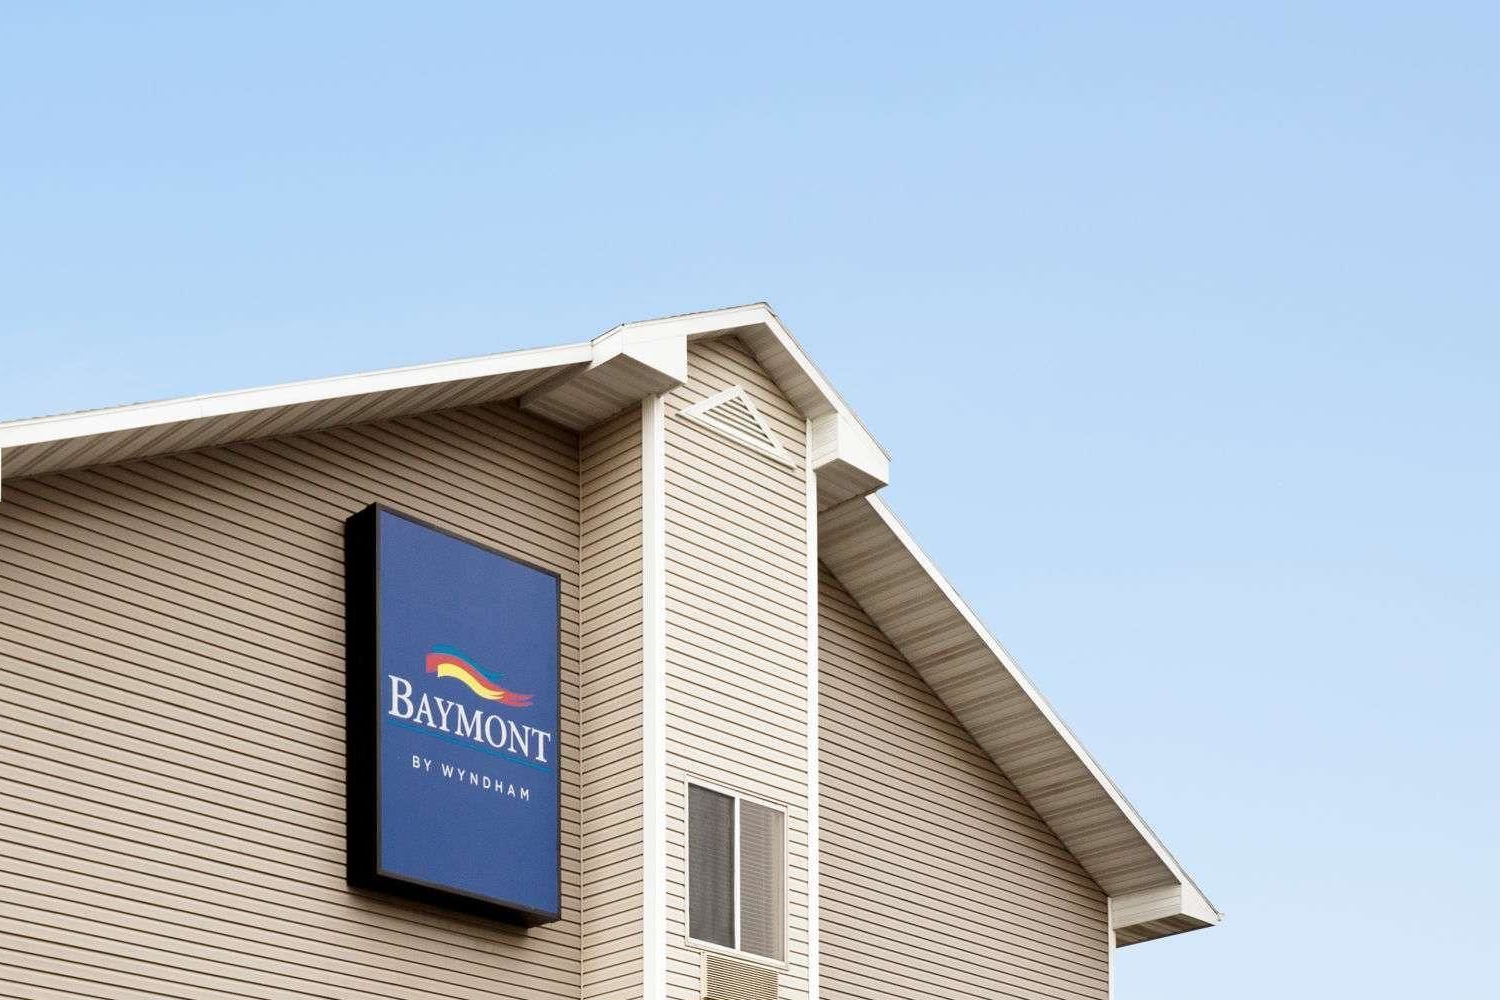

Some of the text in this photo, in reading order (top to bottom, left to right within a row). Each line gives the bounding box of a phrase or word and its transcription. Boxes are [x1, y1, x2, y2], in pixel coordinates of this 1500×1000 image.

[388, 674, 551, 763] BAYMONT
[412, 755, 530, 801] BY WYNDHAM
